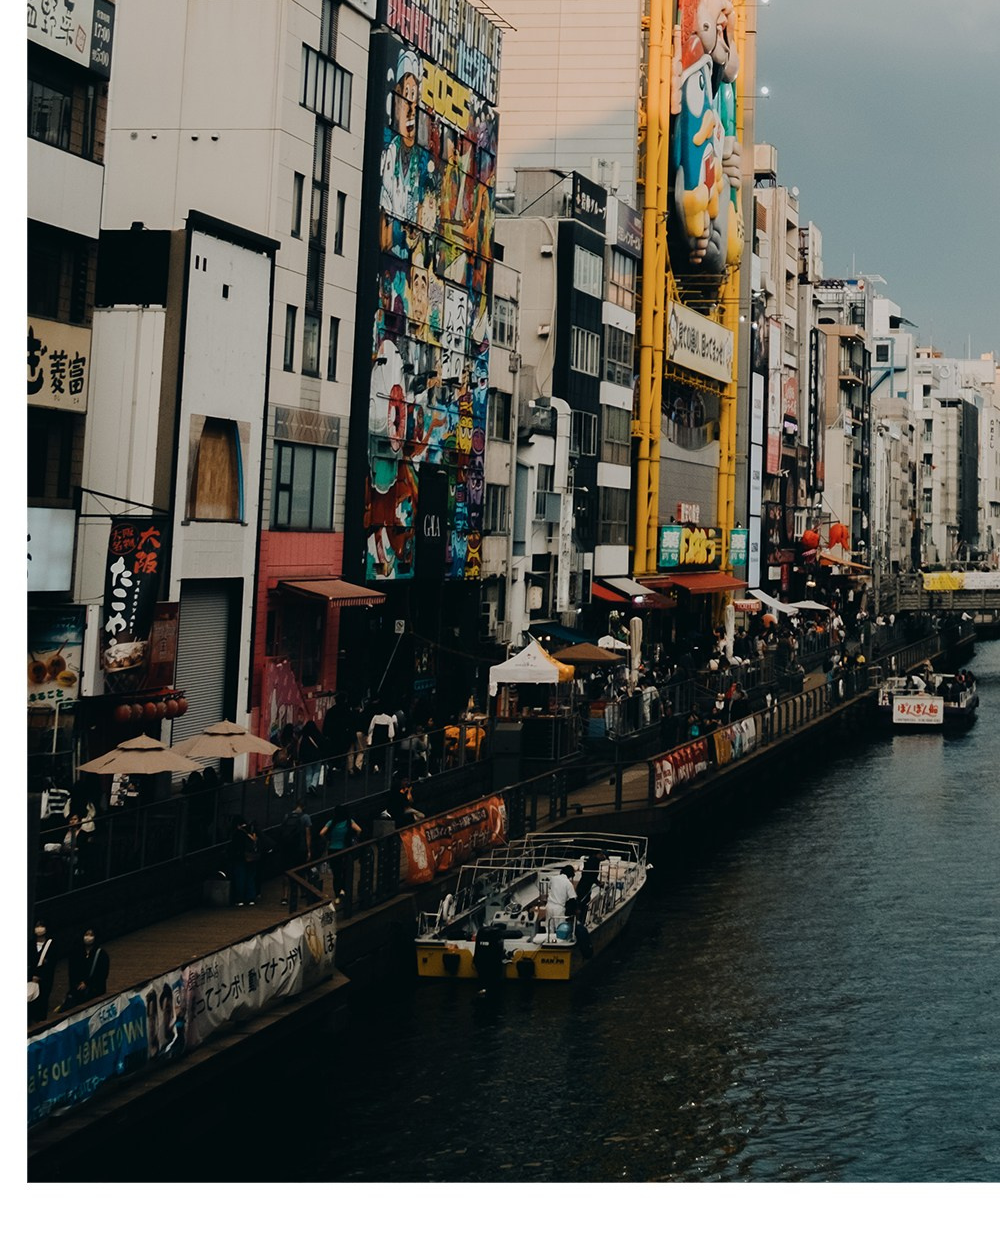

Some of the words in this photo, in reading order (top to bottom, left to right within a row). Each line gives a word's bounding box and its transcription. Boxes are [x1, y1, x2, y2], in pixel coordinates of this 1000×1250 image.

[420, 59, 471, 133] 2025
[133, 525, 161, 574] 大阪
[105, 556, 134, 647] たこや
